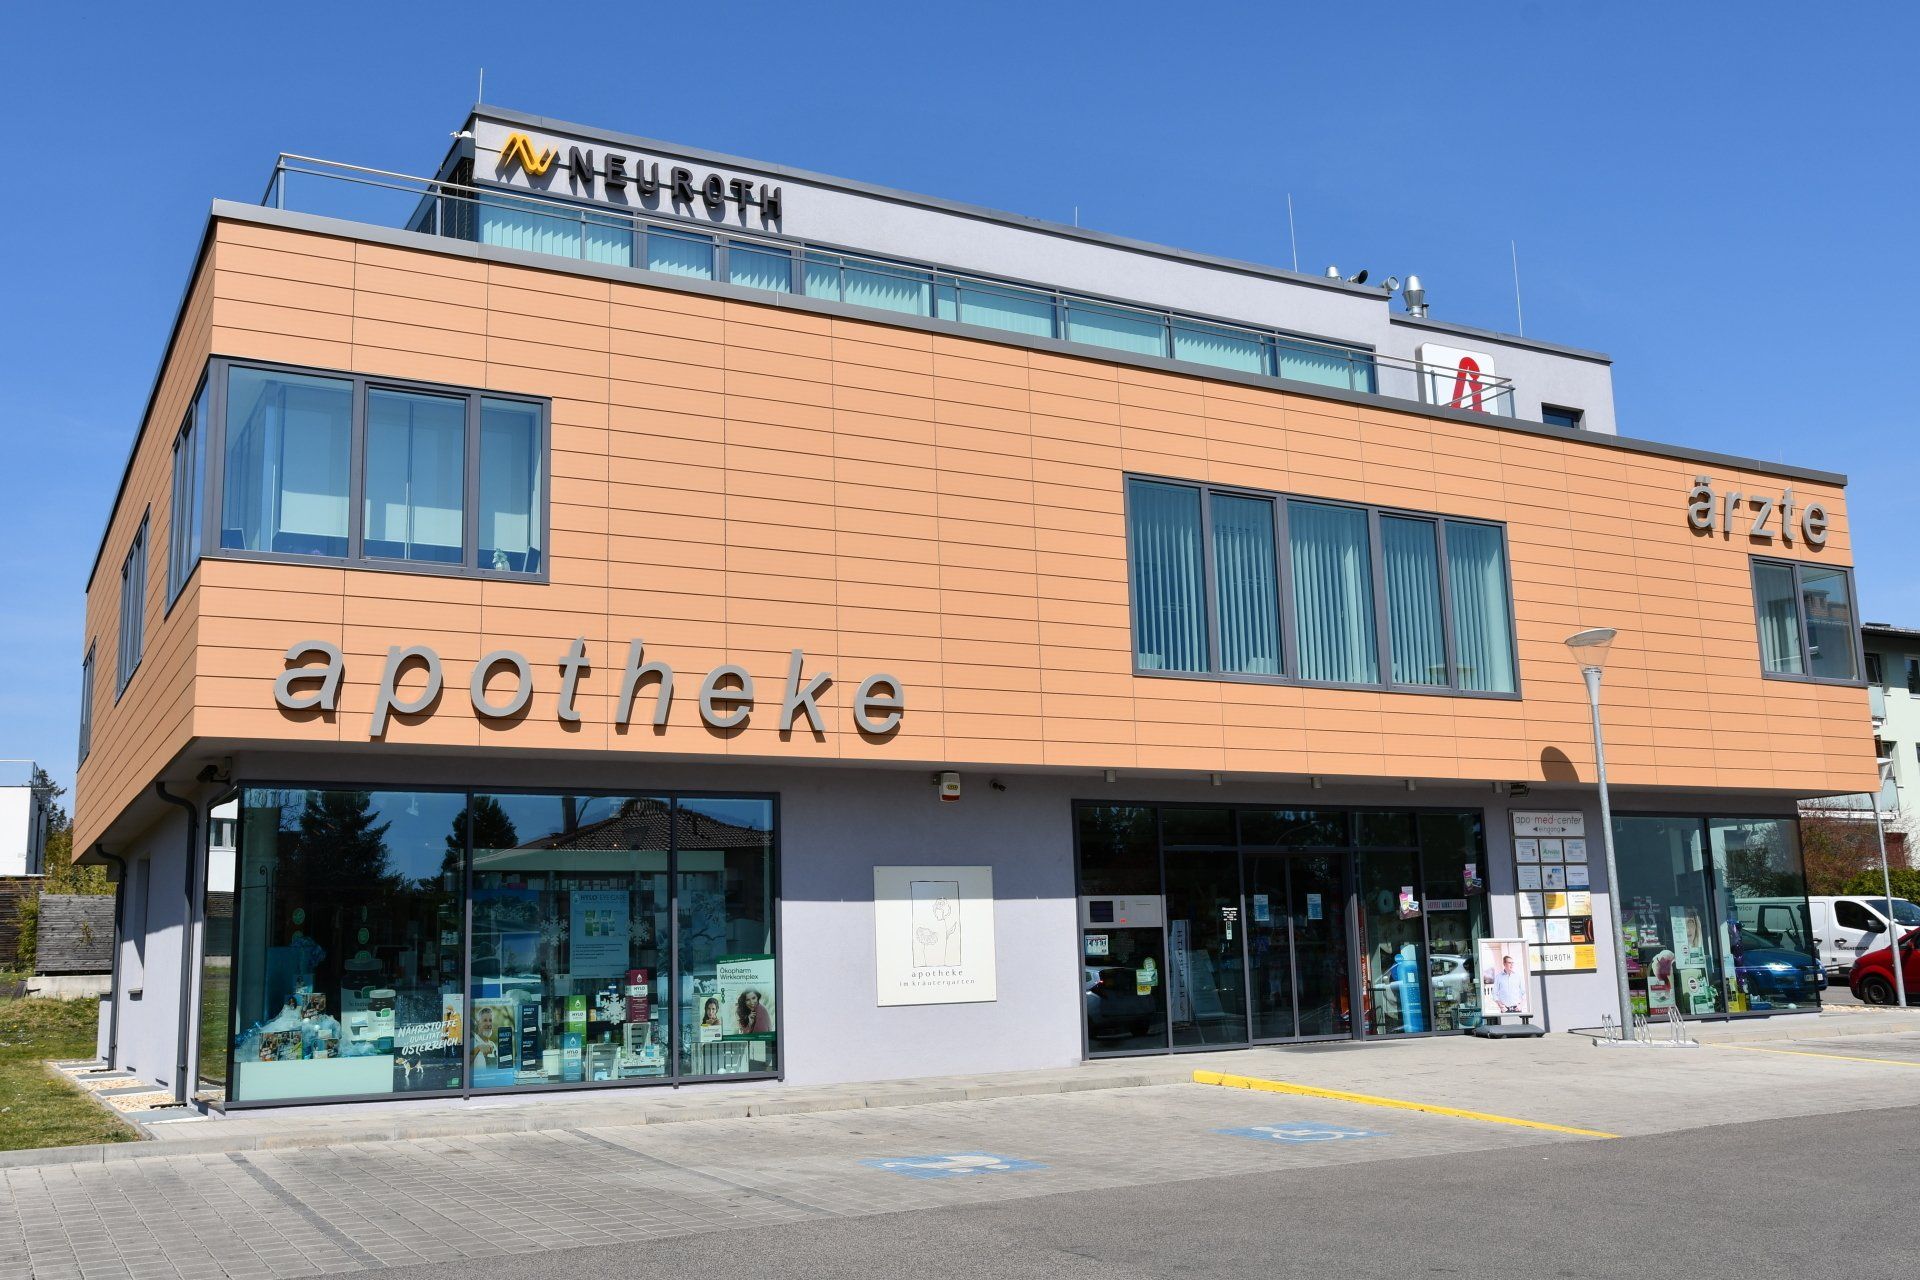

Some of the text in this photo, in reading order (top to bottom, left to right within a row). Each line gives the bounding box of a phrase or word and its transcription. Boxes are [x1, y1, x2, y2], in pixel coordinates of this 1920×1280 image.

[568, 145, 782, 219] NEUROTH
[1688, 474, 1829, 545] ärzte
[273, 636, 906, 738] apotheke
[911, 969, 963, 979] apotheke
[1540, 953, 1571, 962] NEUROTH
[398, 1019, 457, 1038] NÄHRSTOFFE
